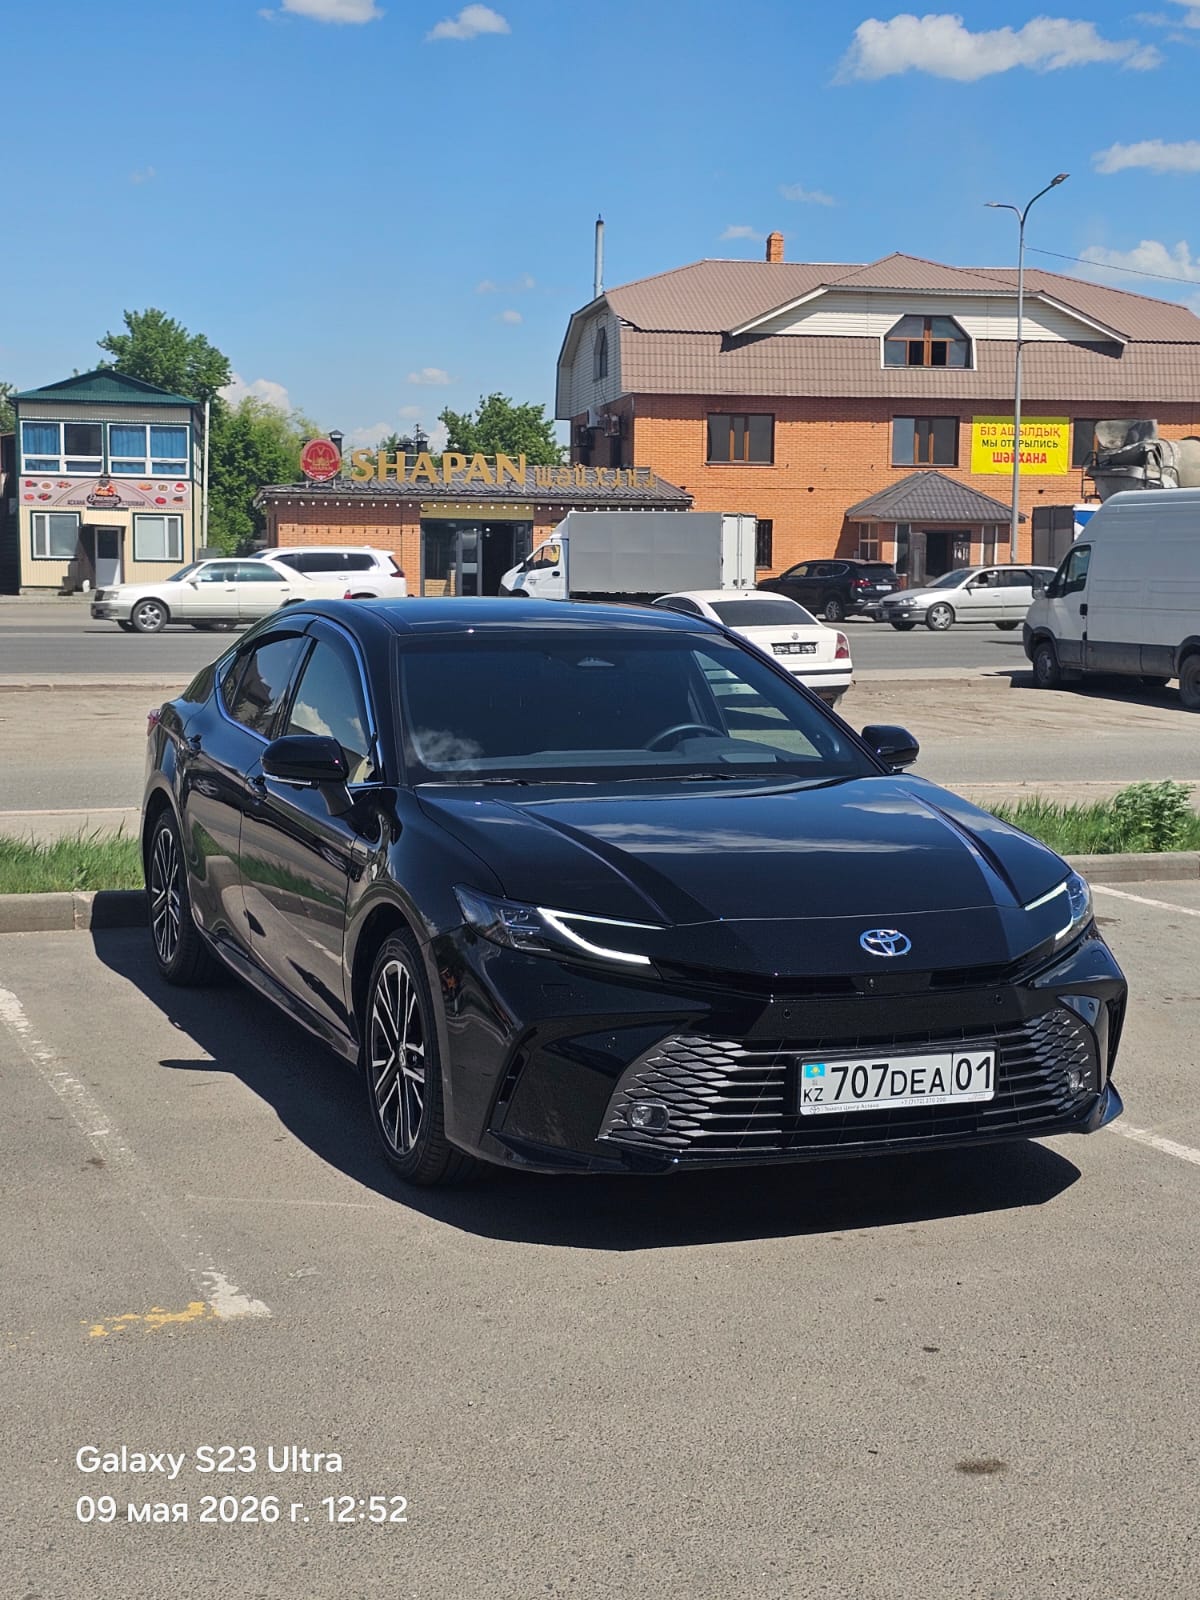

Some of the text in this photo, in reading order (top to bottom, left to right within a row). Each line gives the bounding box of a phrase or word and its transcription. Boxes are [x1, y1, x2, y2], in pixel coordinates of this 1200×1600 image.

[980, 426, 997, 436] БІЗ
[981, 439, 998, 448] МЫ
[351, 449, 527, 486] SHAPAN
[955, 1056, 991, 1091] 01
[803, 1087, 824, 1103] KZ
